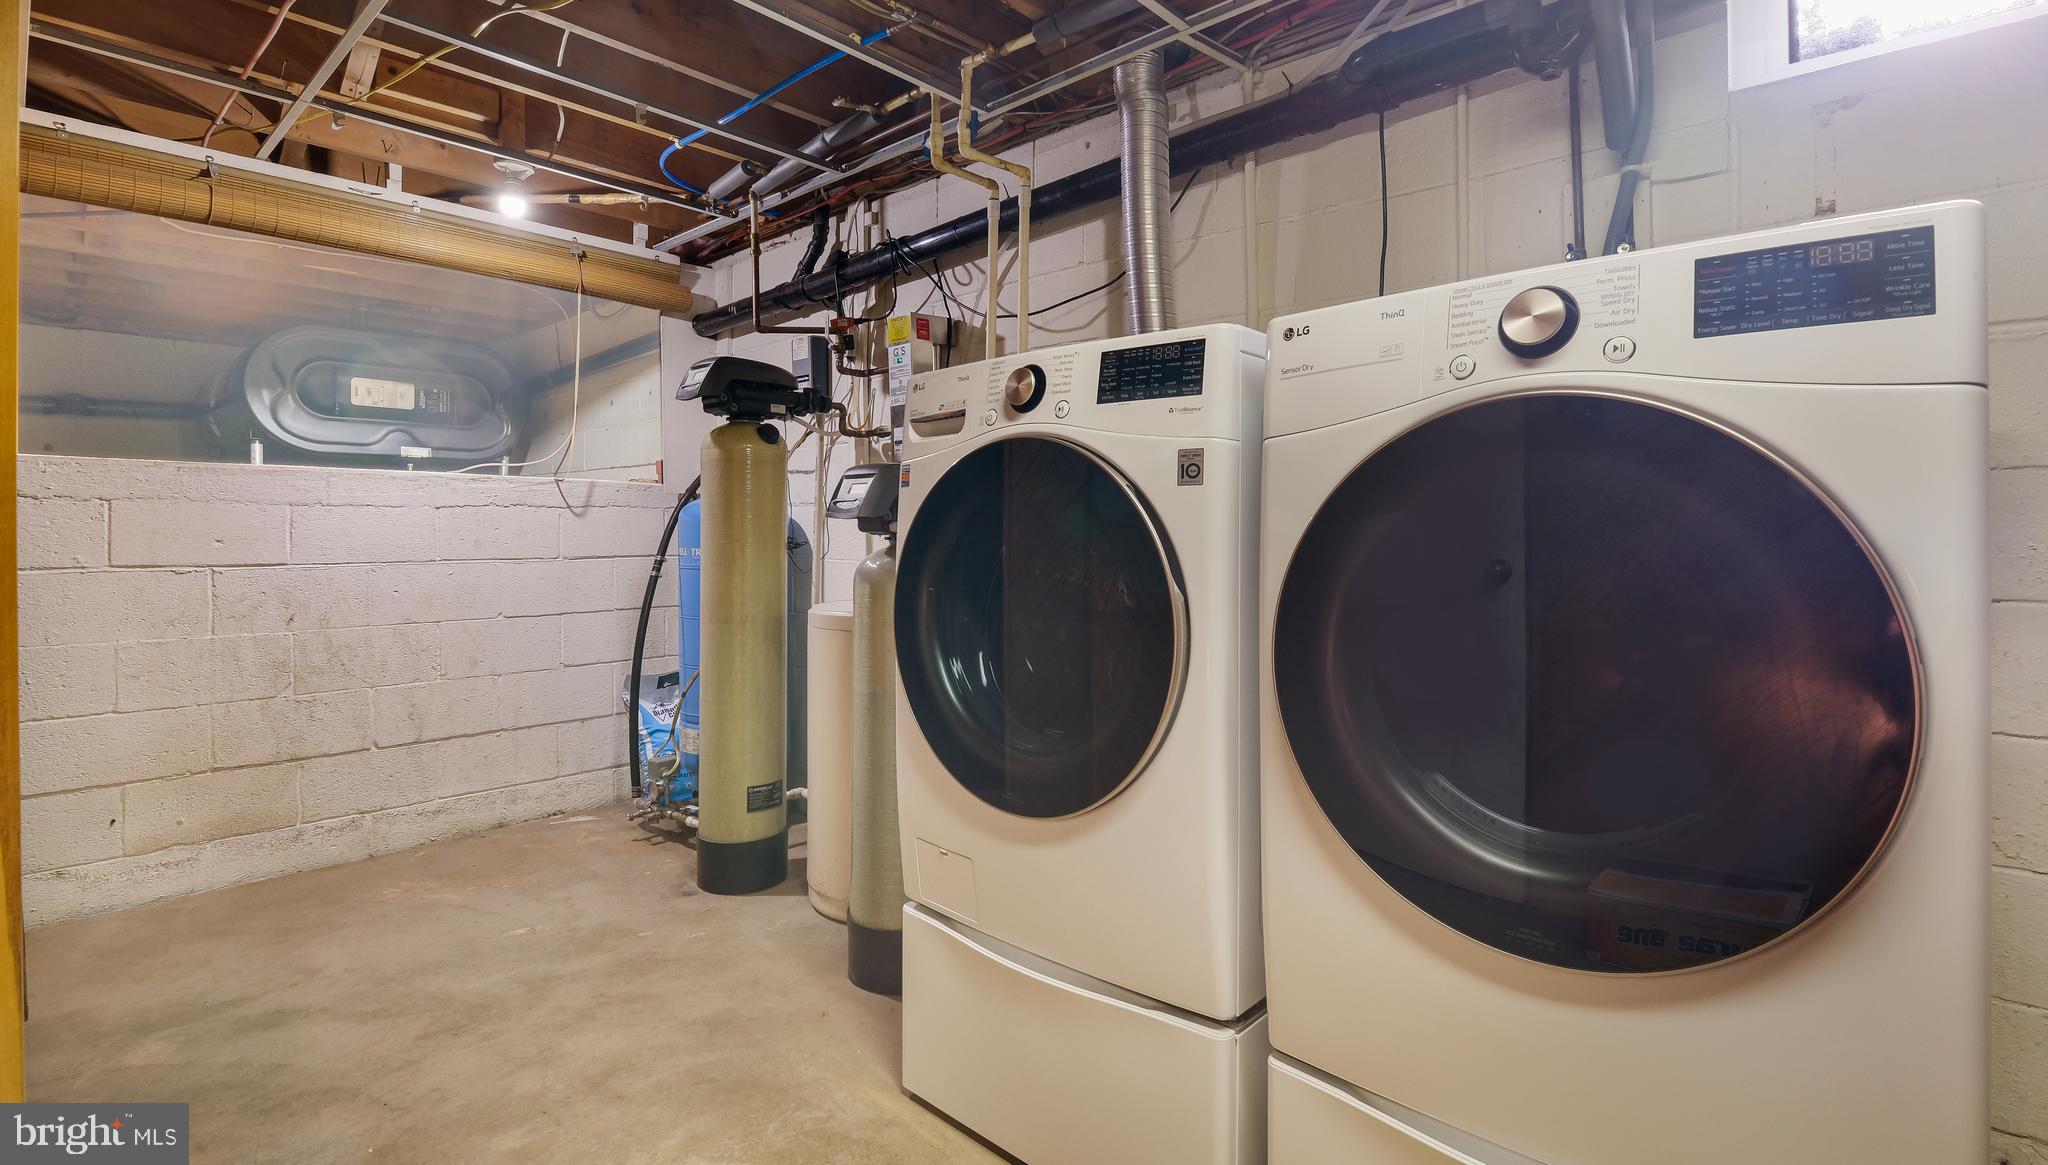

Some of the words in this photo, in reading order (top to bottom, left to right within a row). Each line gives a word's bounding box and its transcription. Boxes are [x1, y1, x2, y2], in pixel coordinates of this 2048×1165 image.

[1605, 265, 1636, 274] Delicates
[1885, 284, 1912, 292] Wrinkle
[1452, 292, 1472, 300] Normal
[1452, 302, 1469, 310] Heavy
[1600, 299, 1622, 307] Speed
[1914, 303, 1932, 311] Signal
[1698, 306, 1718, 314] Reduce
[1852, 310, 1874, 318] Signal
[1380, 309, 1406, 321] ThinQ
[1452, 312, 1474, 320] Bedding
[1828, 312, 1842, 320] Dry
[1451, 318, 1487, 329] Antibacterial
[1594, 318, 1636, 329] Downloaded
[1740, 322, 1753, 330] Dry
[1754, 320, 1771, 328] Level
[1296, 325, 1310, 336] LG
[1698, 326, 1718, 334] Energy
[1720, 324, 1737, 332] Saver
[1450, 342, 1468, 350] Steam
